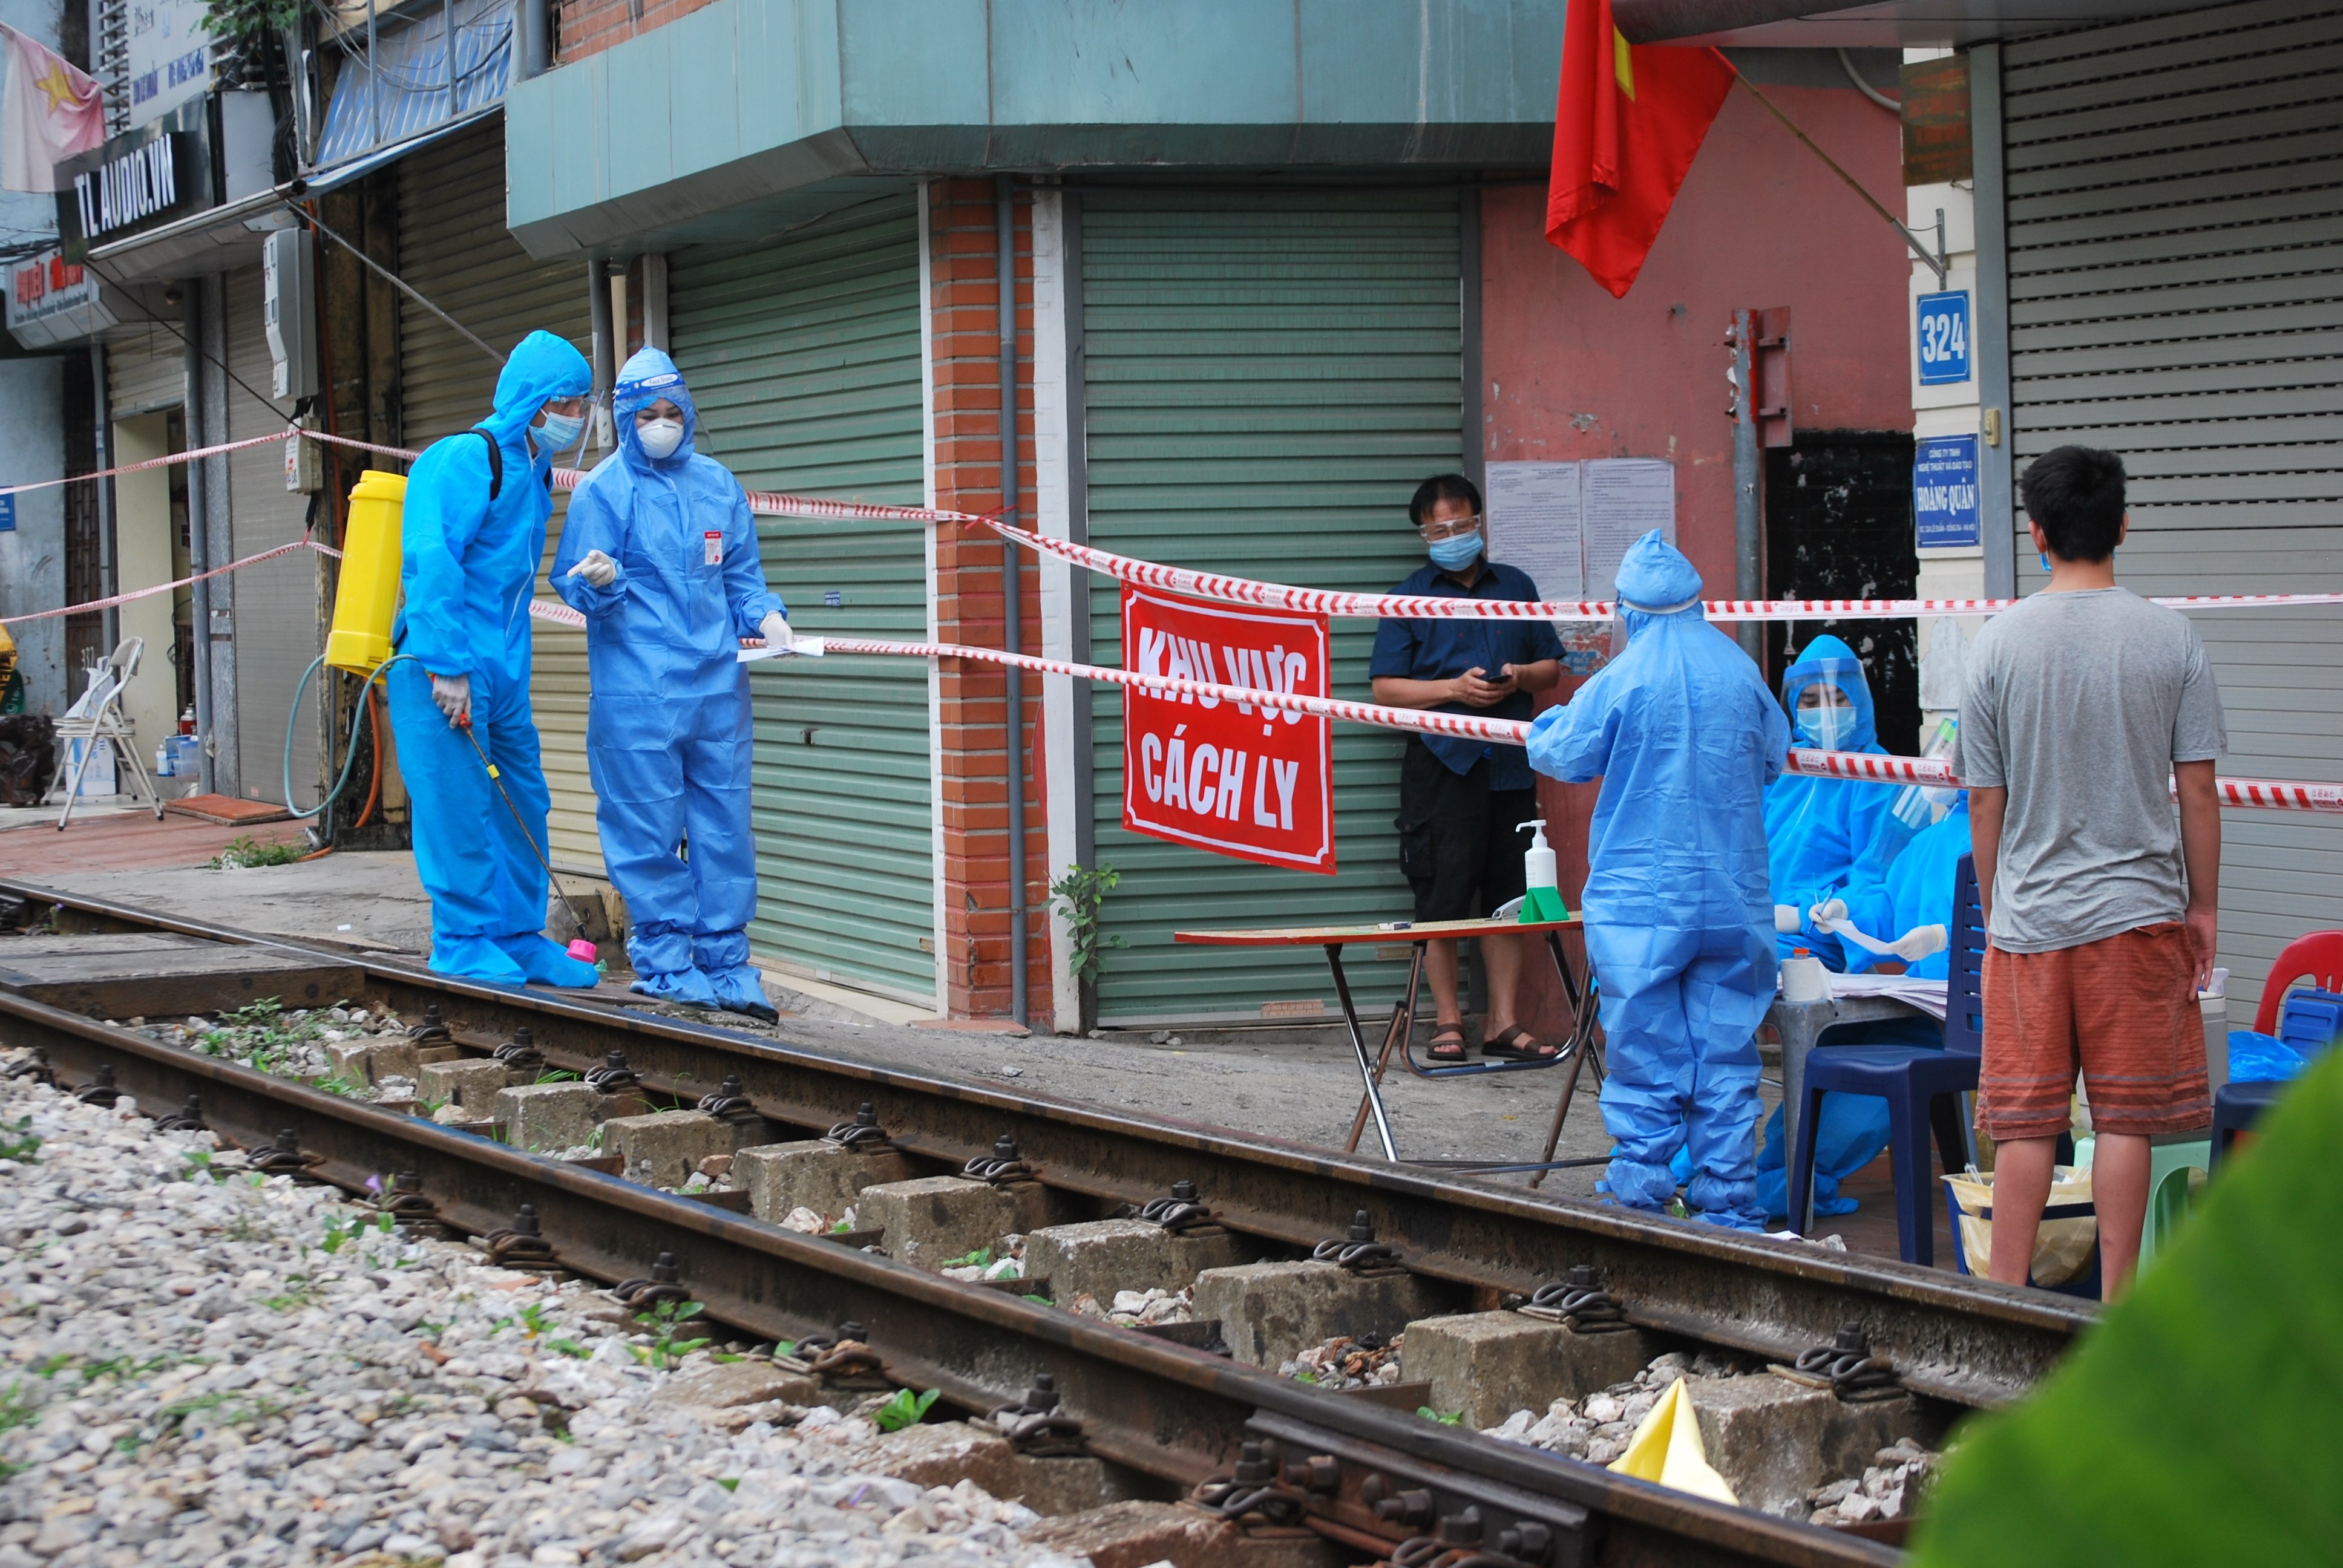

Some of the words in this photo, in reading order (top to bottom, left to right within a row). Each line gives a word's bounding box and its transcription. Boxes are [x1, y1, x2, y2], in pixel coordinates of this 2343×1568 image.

[74, 172, 100, 239] TL
[100, 132, 175, 232] AUDIO.VN
[1922, 313, 1965, 363] 324
[1917, 479, 1948, 512] HOÀNG
[1948, 477, 1974, 516] QUÂN
[1138, 627, 1220, 710] KHU
[1222, 644, 1306, 736] VỰC
[1141, 724, 1247, 822] CÁCH
[1253, 755, 1299, 831] LY
